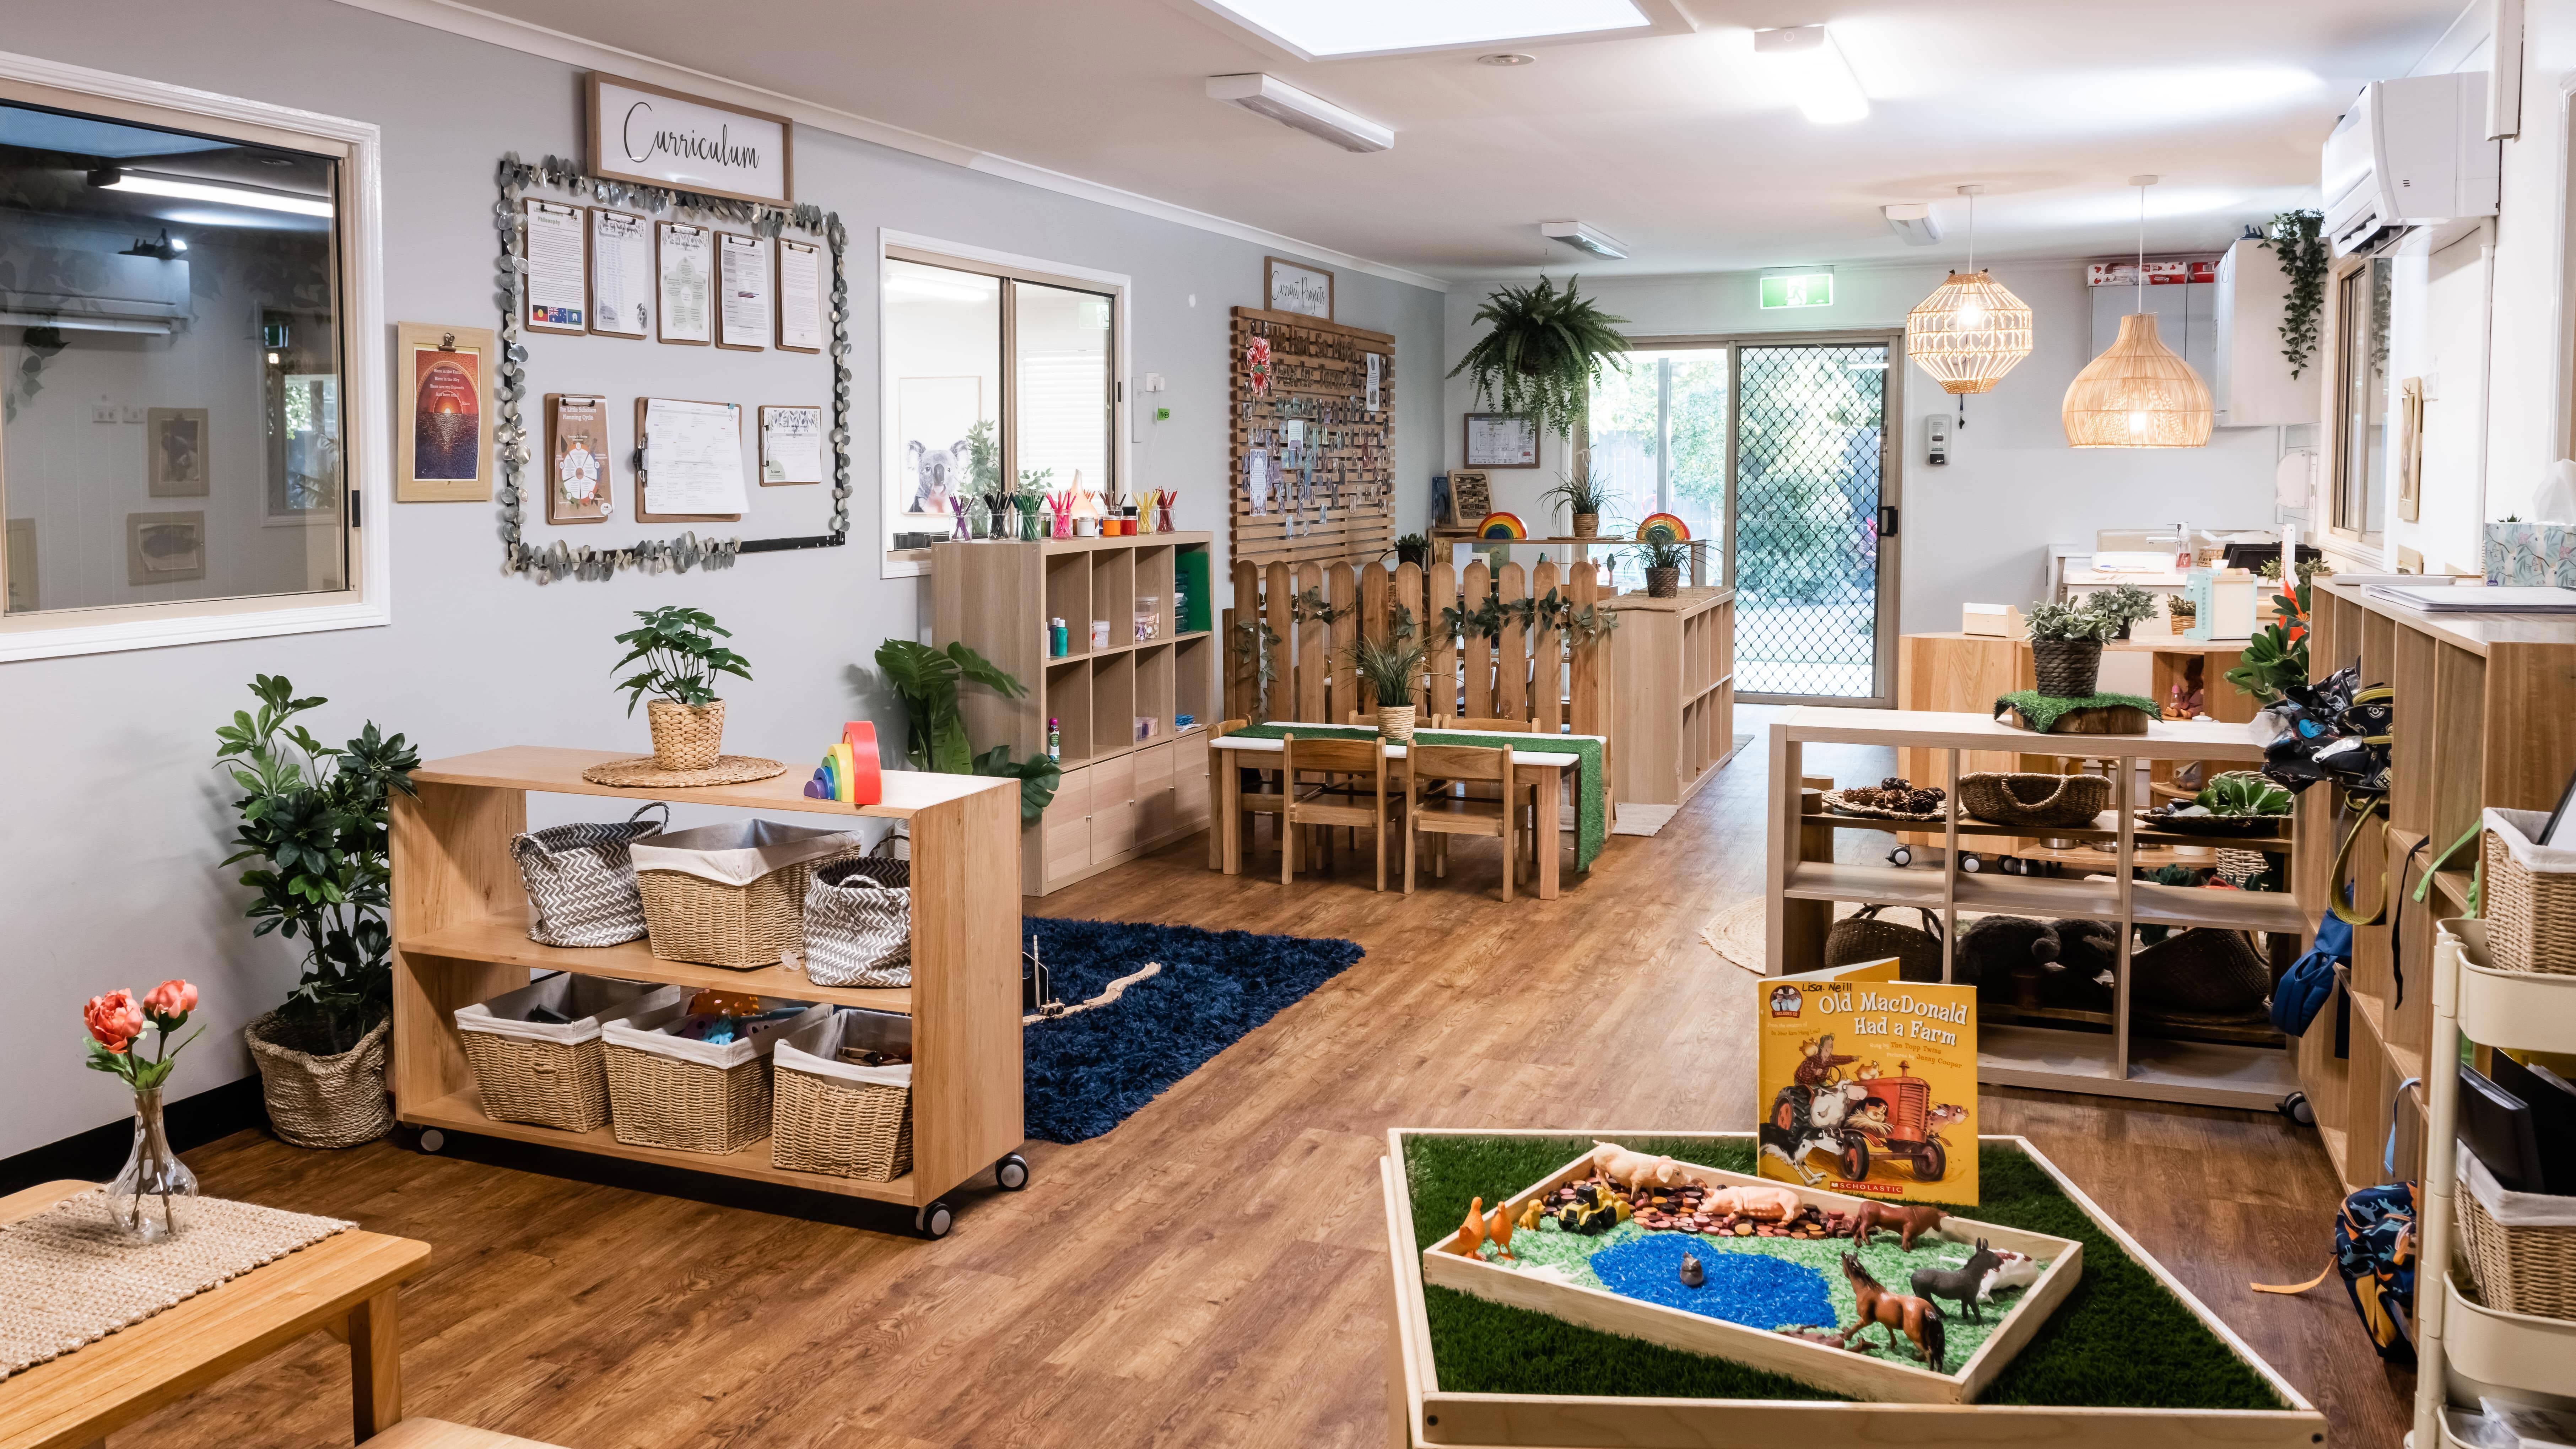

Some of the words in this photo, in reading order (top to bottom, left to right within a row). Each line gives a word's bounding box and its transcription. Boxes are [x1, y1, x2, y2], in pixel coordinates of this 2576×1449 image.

[624, 102, 760, 169] Curriculum
[538, 216, 560, 226] Philosophy
[1271, 270, 1300, 300] Current
[1302, 276, 1325, 315] Projects
[1829, 983, 1852, 993] Neill
[1818, 993, 1853, 1014] Old
[1860, 992, 1968, 1026] MacDonald
[1854, 1016, 1888, 1035] Had
[1894, 1023, 1903, 1037] a
[1910, 1020, 1957, 1047] Farm
[1905, 1043, 1921, 1052] Topp
[1923, 1045, 1942, 1054] Twins
[1916, 1054, 1935, 1065] Jenny
[1938, 1058, 1962, 1069] Cooper
[1840, 1183, 1902, 1193] SCHOLASTIC
